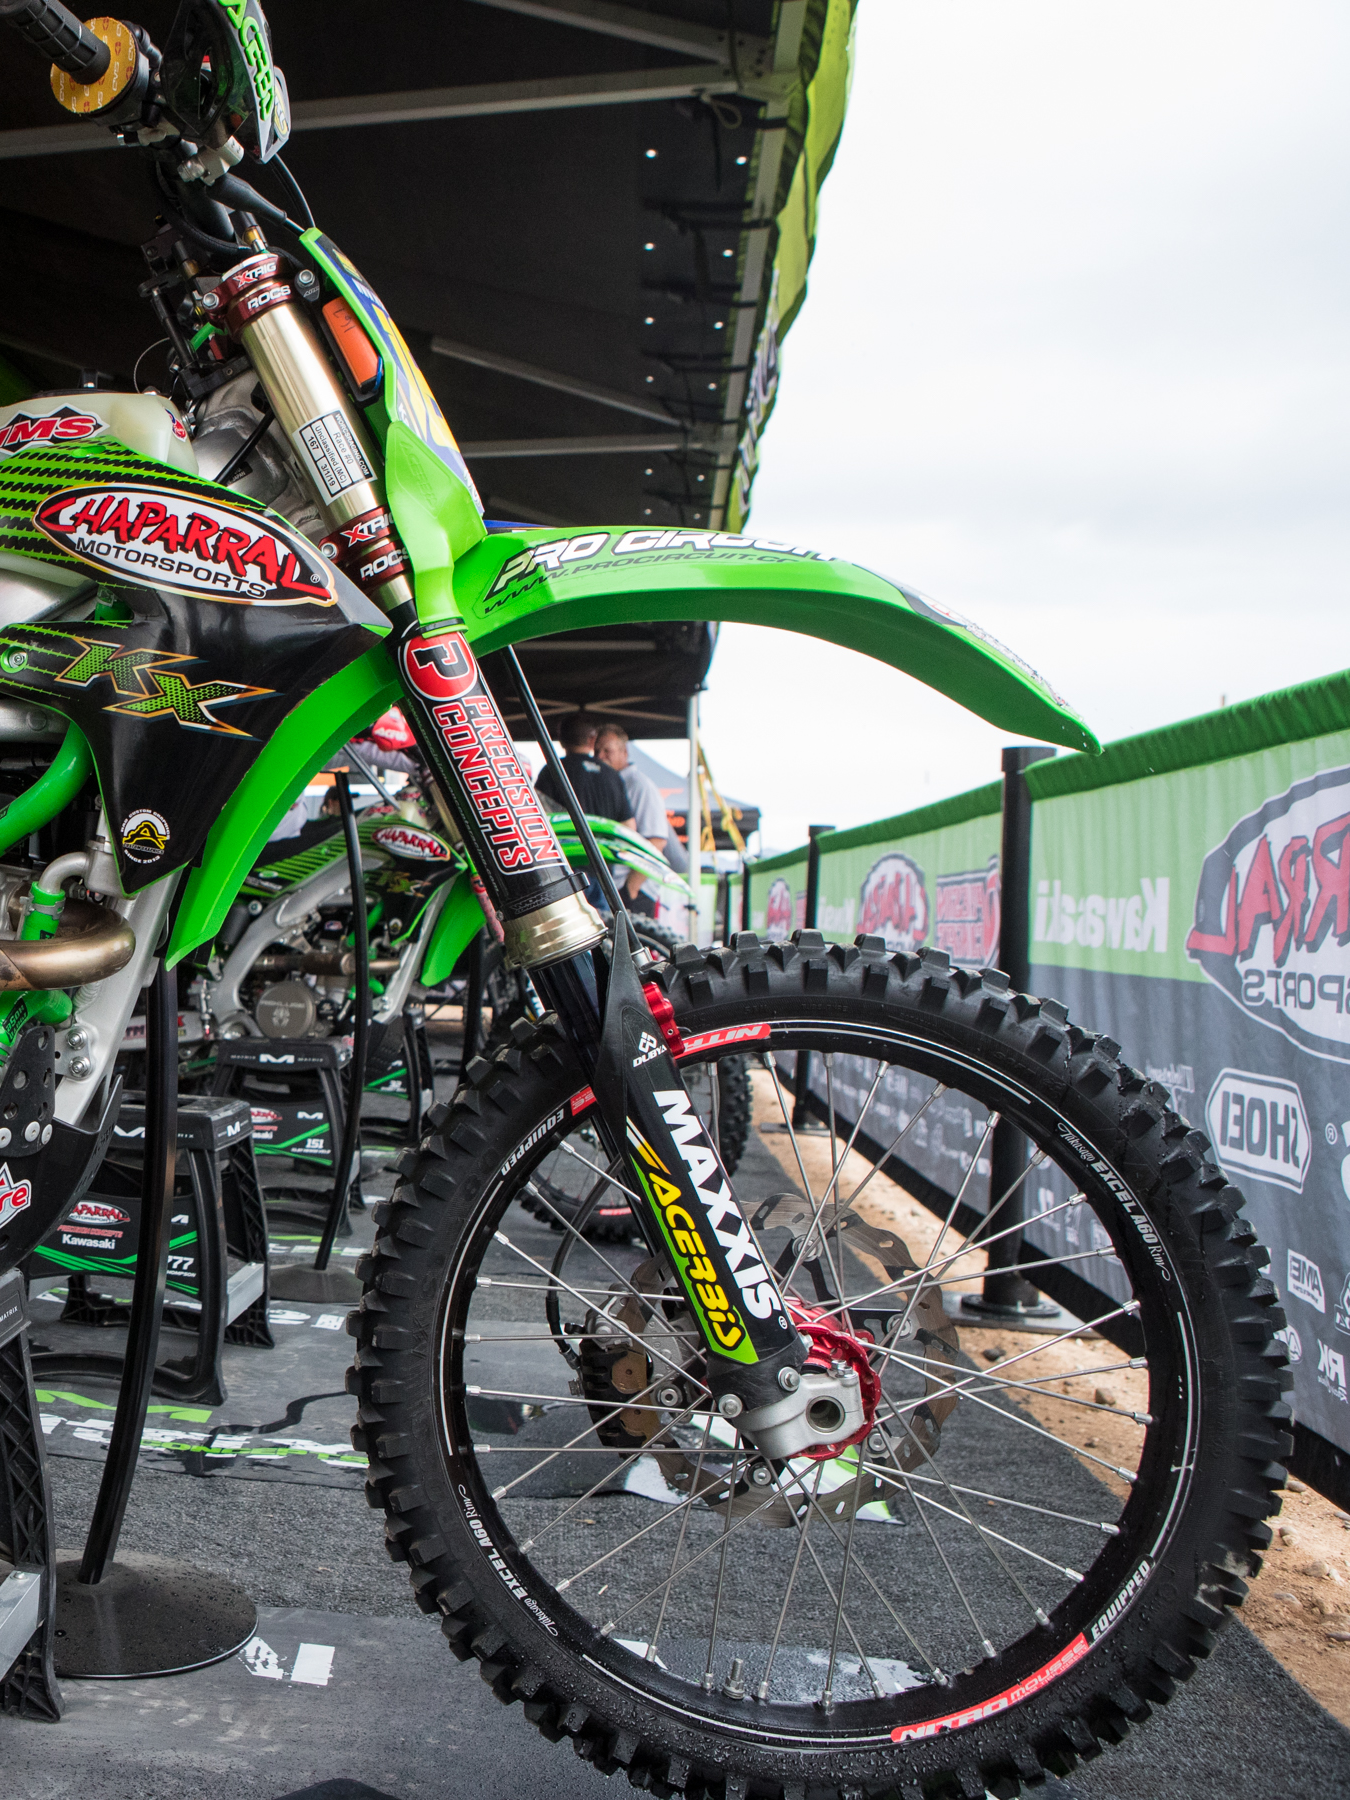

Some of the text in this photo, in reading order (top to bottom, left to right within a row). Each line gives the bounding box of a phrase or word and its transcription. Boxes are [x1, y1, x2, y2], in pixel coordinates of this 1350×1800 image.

[234, 261, 278, 288] XTRIG
[247, 284, 292, 311] ROCS
[307, 435, 320, 451] 167
[314, 425, 348, 484] Unclassified (MC)
[332, 432, 348, 453] Race
[334, 412, 370, 476] WORCSRACING.COM
[320, 463, 337, 487] 3/1/19
[40, 494, 332, 600] CHAPARRAL
[75, 537, 268, 599] MOTORSPORTS
[484, 532, 611, 602] PRO
[432, 700, 534, 869] CONCEPTS
[461, 694, 562, 862] PRECISION
[124, 849, 142, 864] SINCE
[632, 1043, 668, 1068] DUBYA
[304, 1137, 325, 1150] 151
[500, 1107, 566, 1177] EQUIPPED
[652, 1089, 783, 1320] MAXXIS
[1089, 1160, 1137, 1214] EXCEL
[1129, 1213, 1160, 1245] A60
[1147, 1244, 1172, 1283] Rim
[61, 1233, 117, 1250] Kawasaki
[458, 1483, 479, 1519] Rim
[469, 1518, 495, 1548] A60
[487, 1547, 530, 1600] EXCEL
[899, 1559, 1152, 1742] NITRO MOUSSE EQUIPPED
